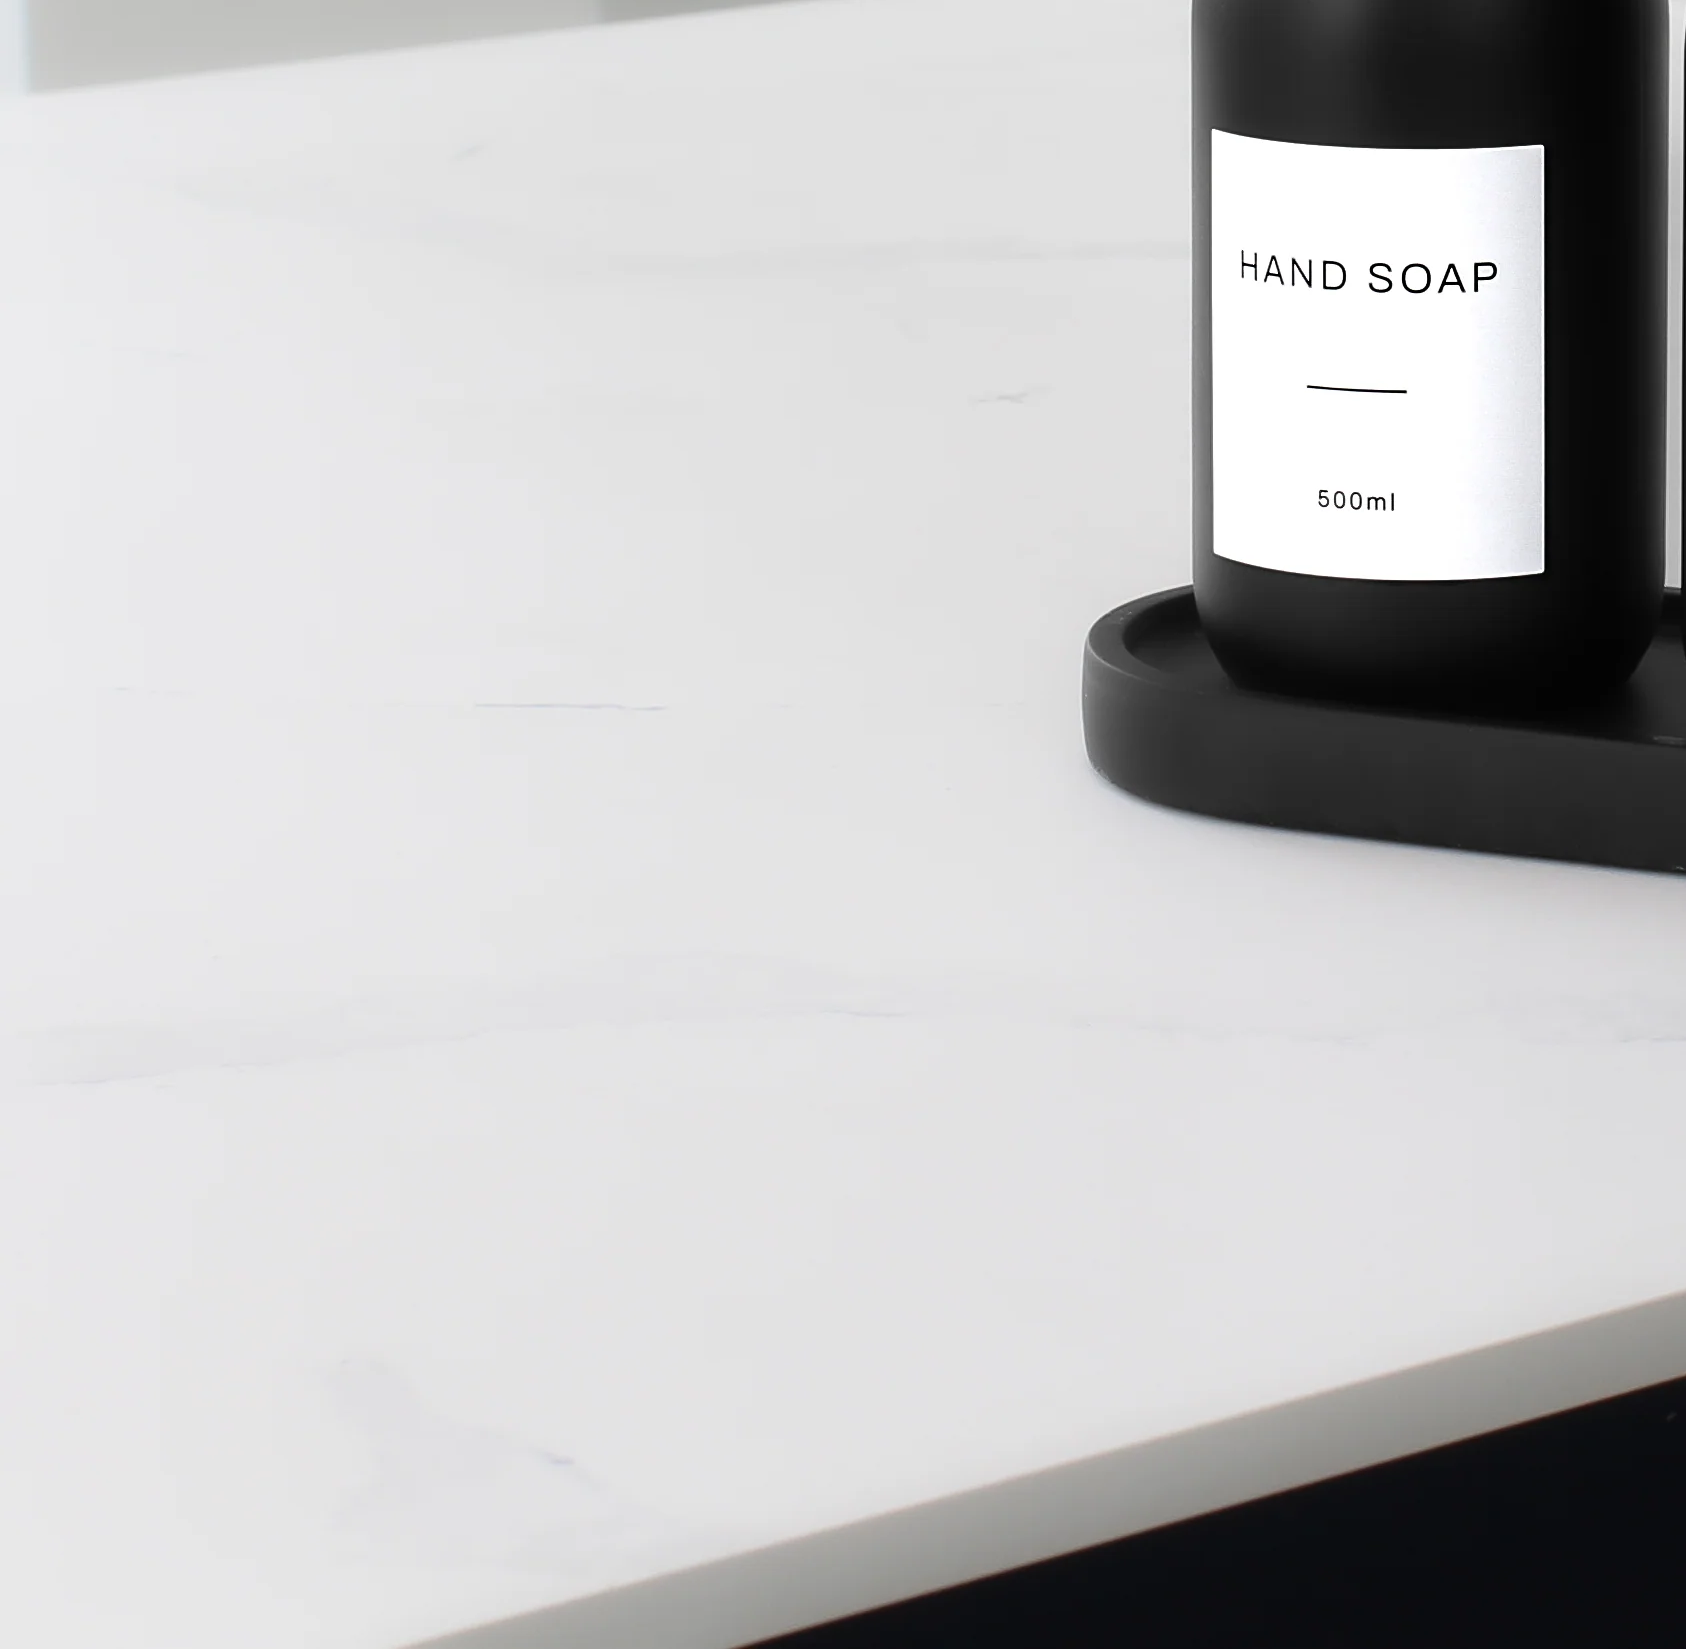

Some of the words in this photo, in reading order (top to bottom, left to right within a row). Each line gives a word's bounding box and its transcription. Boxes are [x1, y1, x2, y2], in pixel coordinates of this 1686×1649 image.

[1240, 248, 1347, 292] HAND
[1368, 261, 1499, 295] SOAP
[1317, 488, 1396, 513] 500ml
